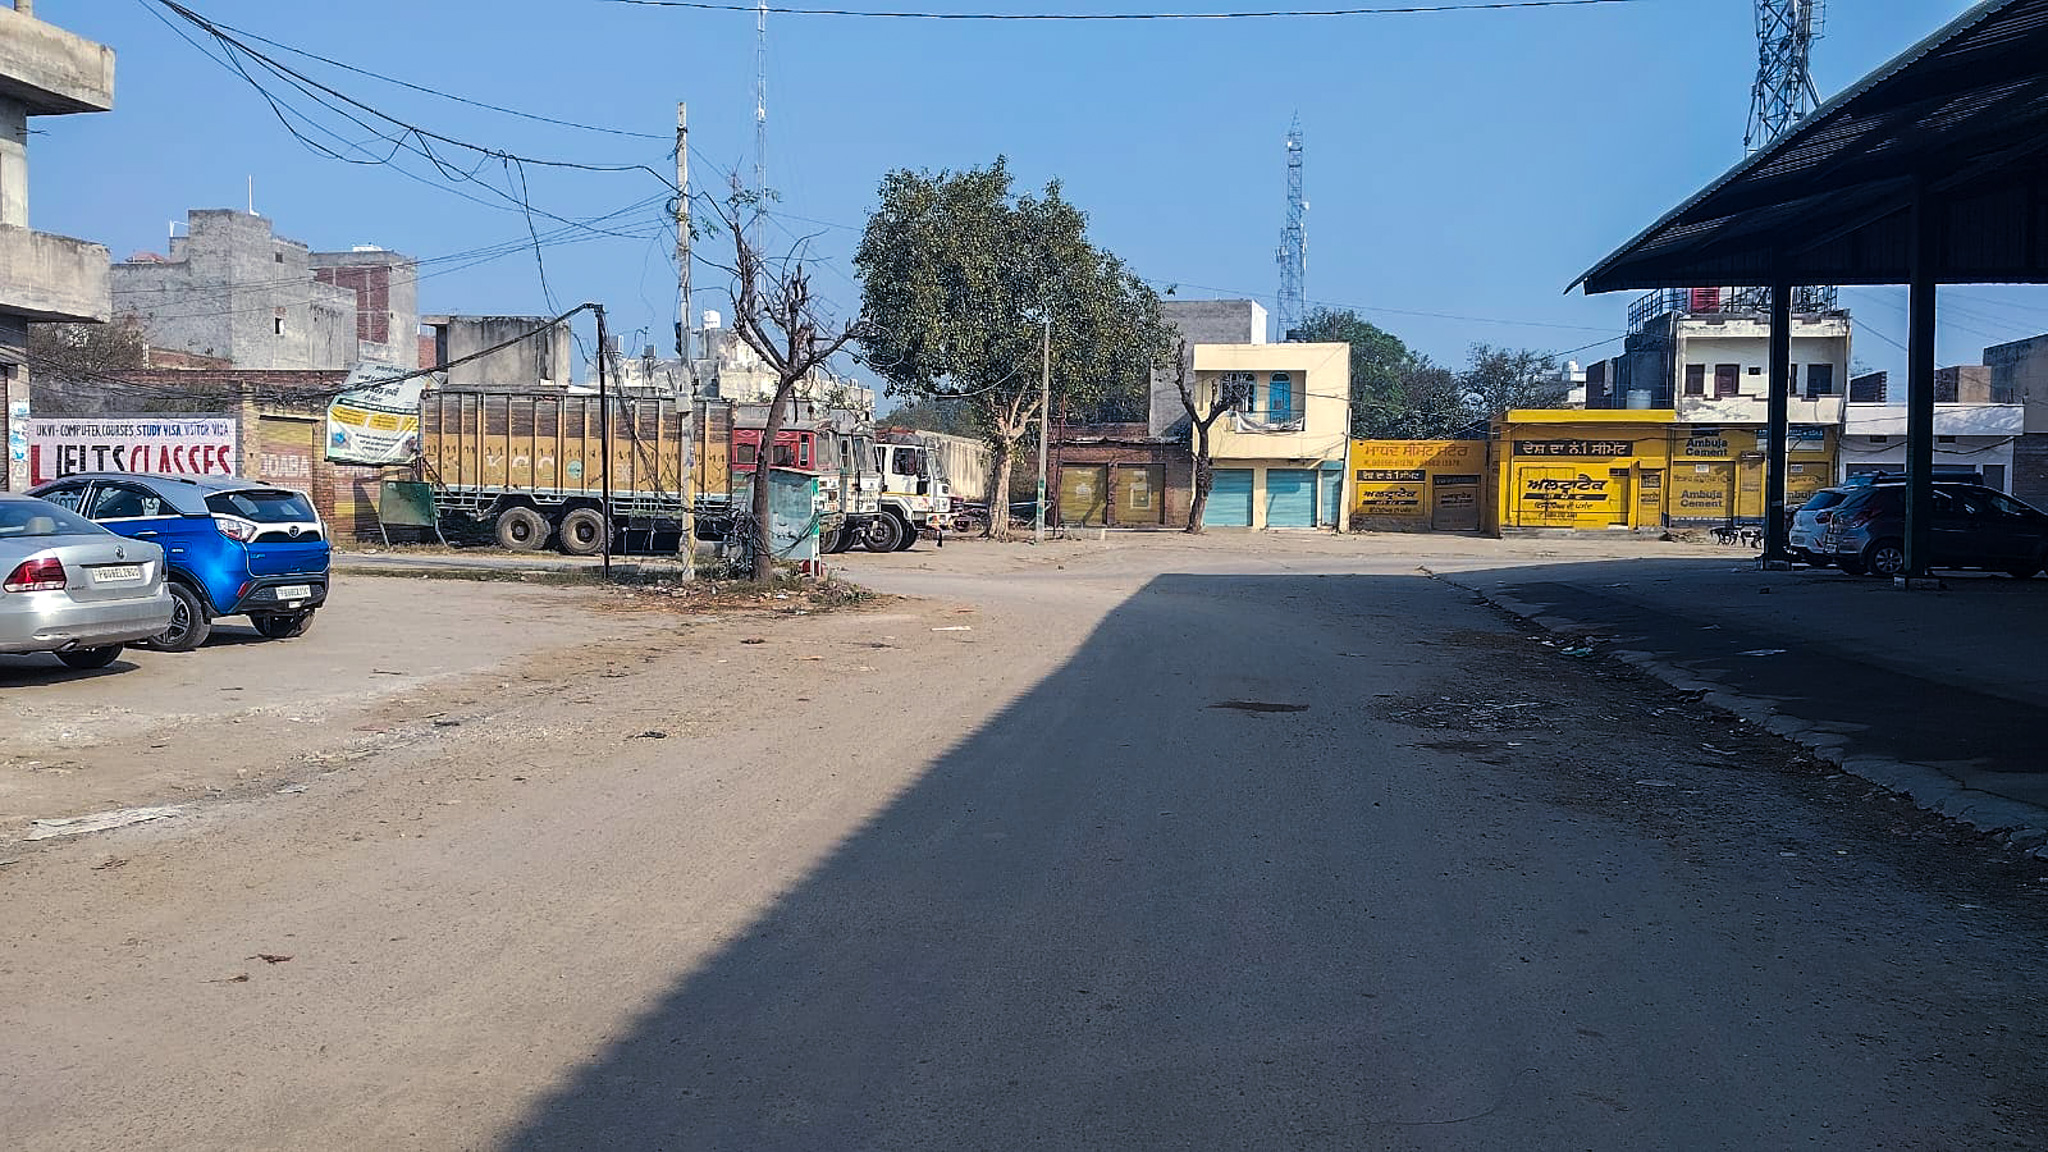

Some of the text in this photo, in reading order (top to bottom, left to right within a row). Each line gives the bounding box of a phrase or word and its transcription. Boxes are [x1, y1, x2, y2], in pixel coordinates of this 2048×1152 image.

[136, 424, 161, 437] STUDY
[1686, 438, 1728, 449] Ambuja
[1686, 448, 1728, 457] Cement
[1681, 489, 1723, 500] Ambuja
[1680, 499, 1723, 508] Cement
